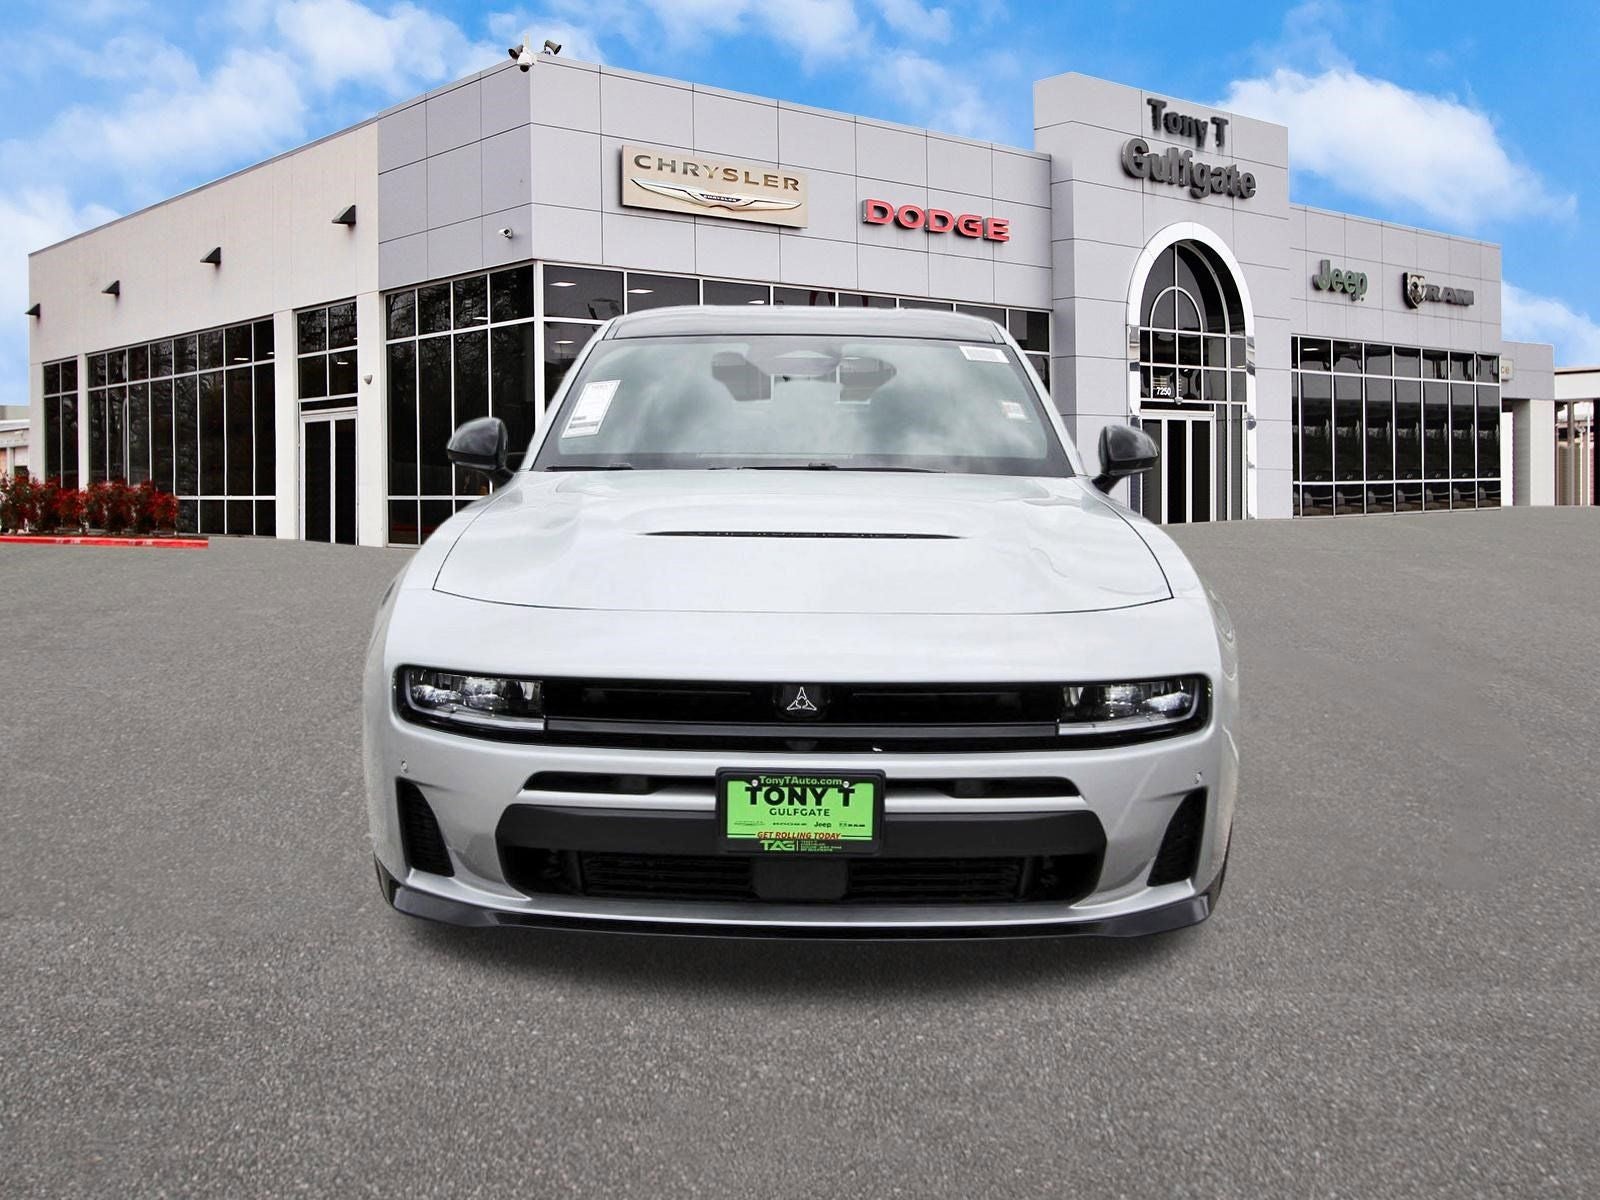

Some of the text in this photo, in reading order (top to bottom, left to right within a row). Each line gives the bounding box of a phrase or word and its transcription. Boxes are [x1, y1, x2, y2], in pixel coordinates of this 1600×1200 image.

[1147, 98, 1229, 147] Tony T
[634, 154, 800, 192] CHRYSLER
[1121, 138, 1256, 199] Gulfgate
[862, 198, 1010, 242] DODGE
[1312, 259, 1368, 302] Jeep
[1425, 284, 1475, 306] RAM
[1156, 386, 1172, 396] 7250
[759, 775, 843, 786] TonyTAuto.com
[745, 786, 856, 807] TONY T
[769, 807, 831, 817] GULFGATE
[757, 831, 841, 840] GET ROLLING TODAY
[814, 821, 832, 829] Jeep
[760, 839, 796, 851] TAG
